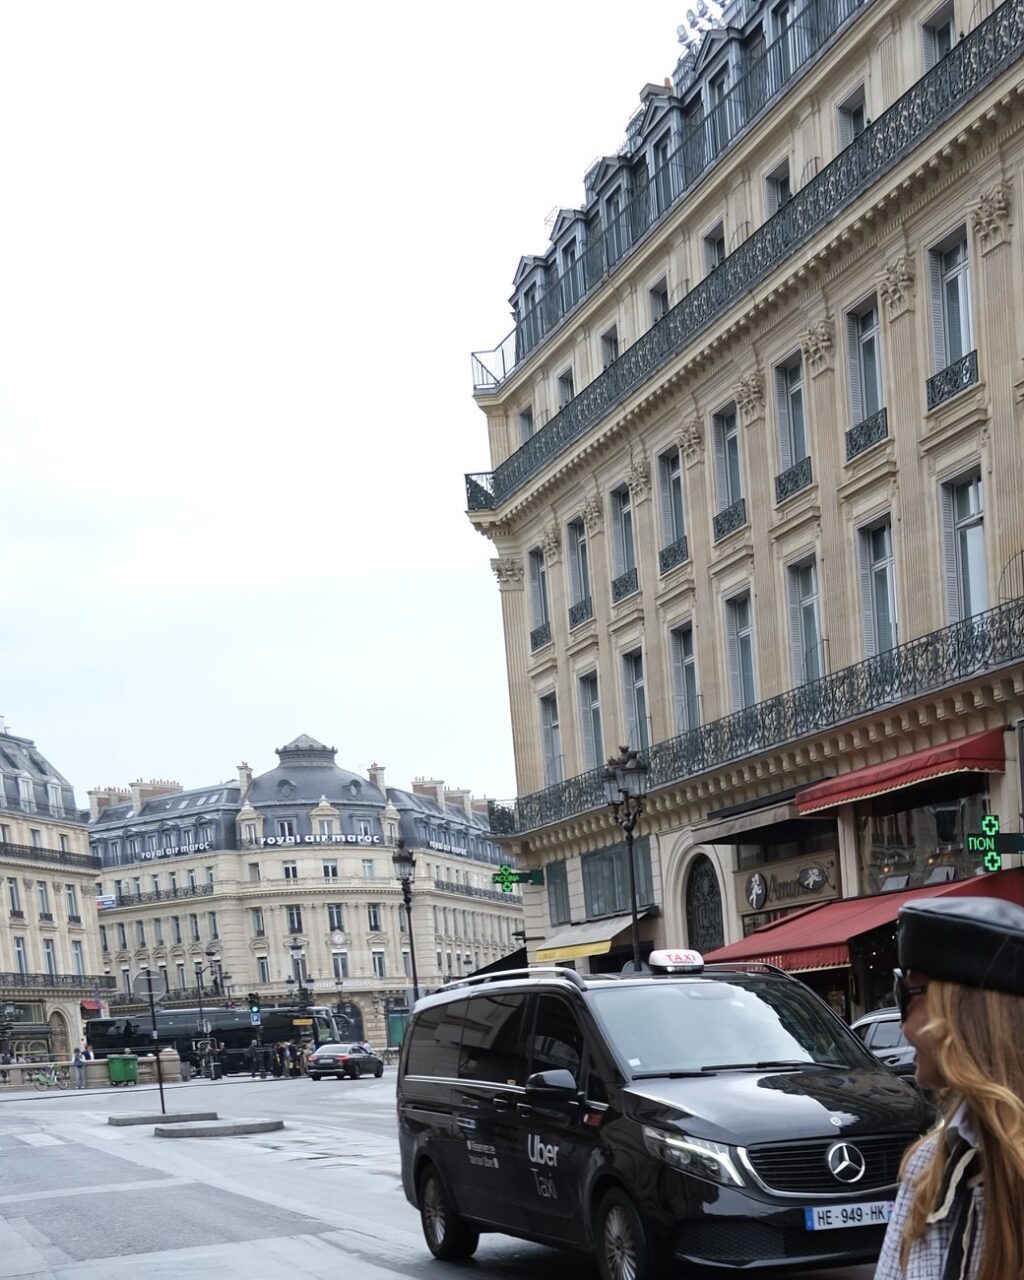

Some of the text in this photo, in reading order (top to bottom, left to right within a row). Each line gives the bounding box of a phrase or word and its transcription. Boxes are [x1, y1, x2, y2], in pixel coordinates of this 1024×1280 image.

[261, 833, 380, 845] royal air maroc
[141, 841, 210, 860] royal air maroc
[665, 953, 697, 962] TAXI
[528, 1133, 559, 1167] Uber
[530, 1168, 558, 1199] Taxi
